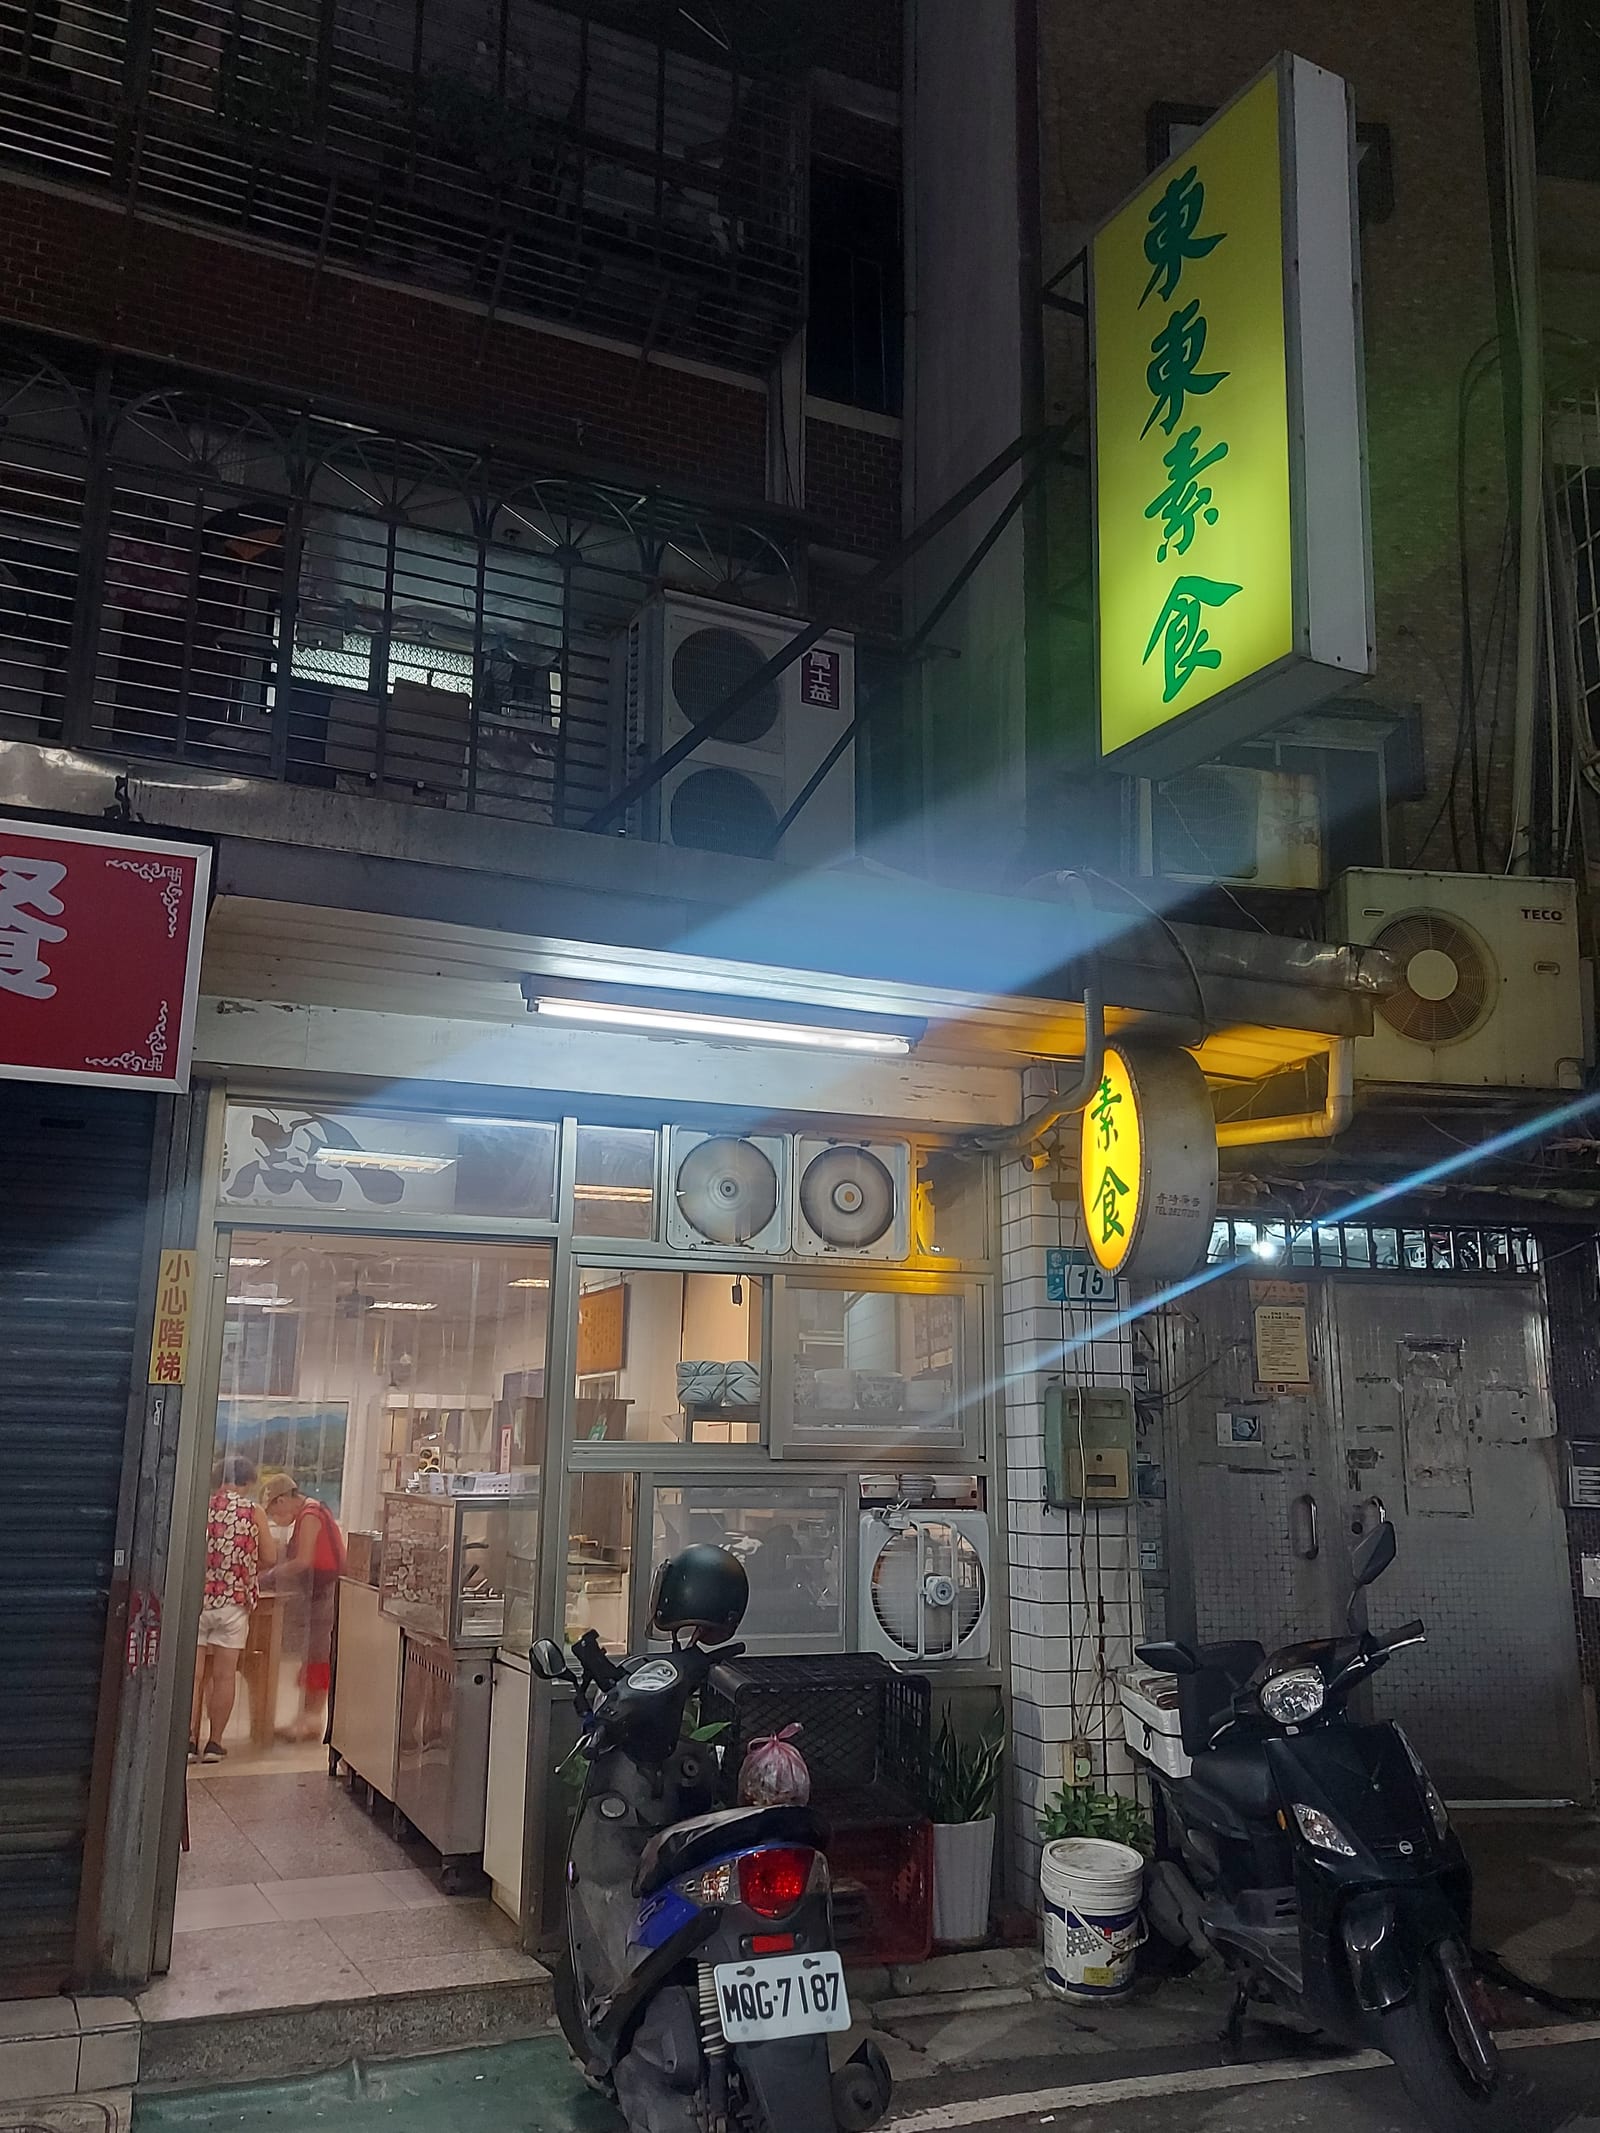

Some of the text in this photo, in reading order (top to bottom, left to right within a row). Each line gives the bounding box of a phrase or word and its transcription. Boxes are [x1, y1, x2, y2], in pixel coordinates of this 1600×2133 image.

[1137, 164, 1244, 704] 東東素食
[1520, 908, 1563, 921] TECO
[1090, 1075, 1130, 1245] 素食
[155, 1253, 190, 1383] 小心階梯
[721, 1972, 840, 2023] MQG-7187
